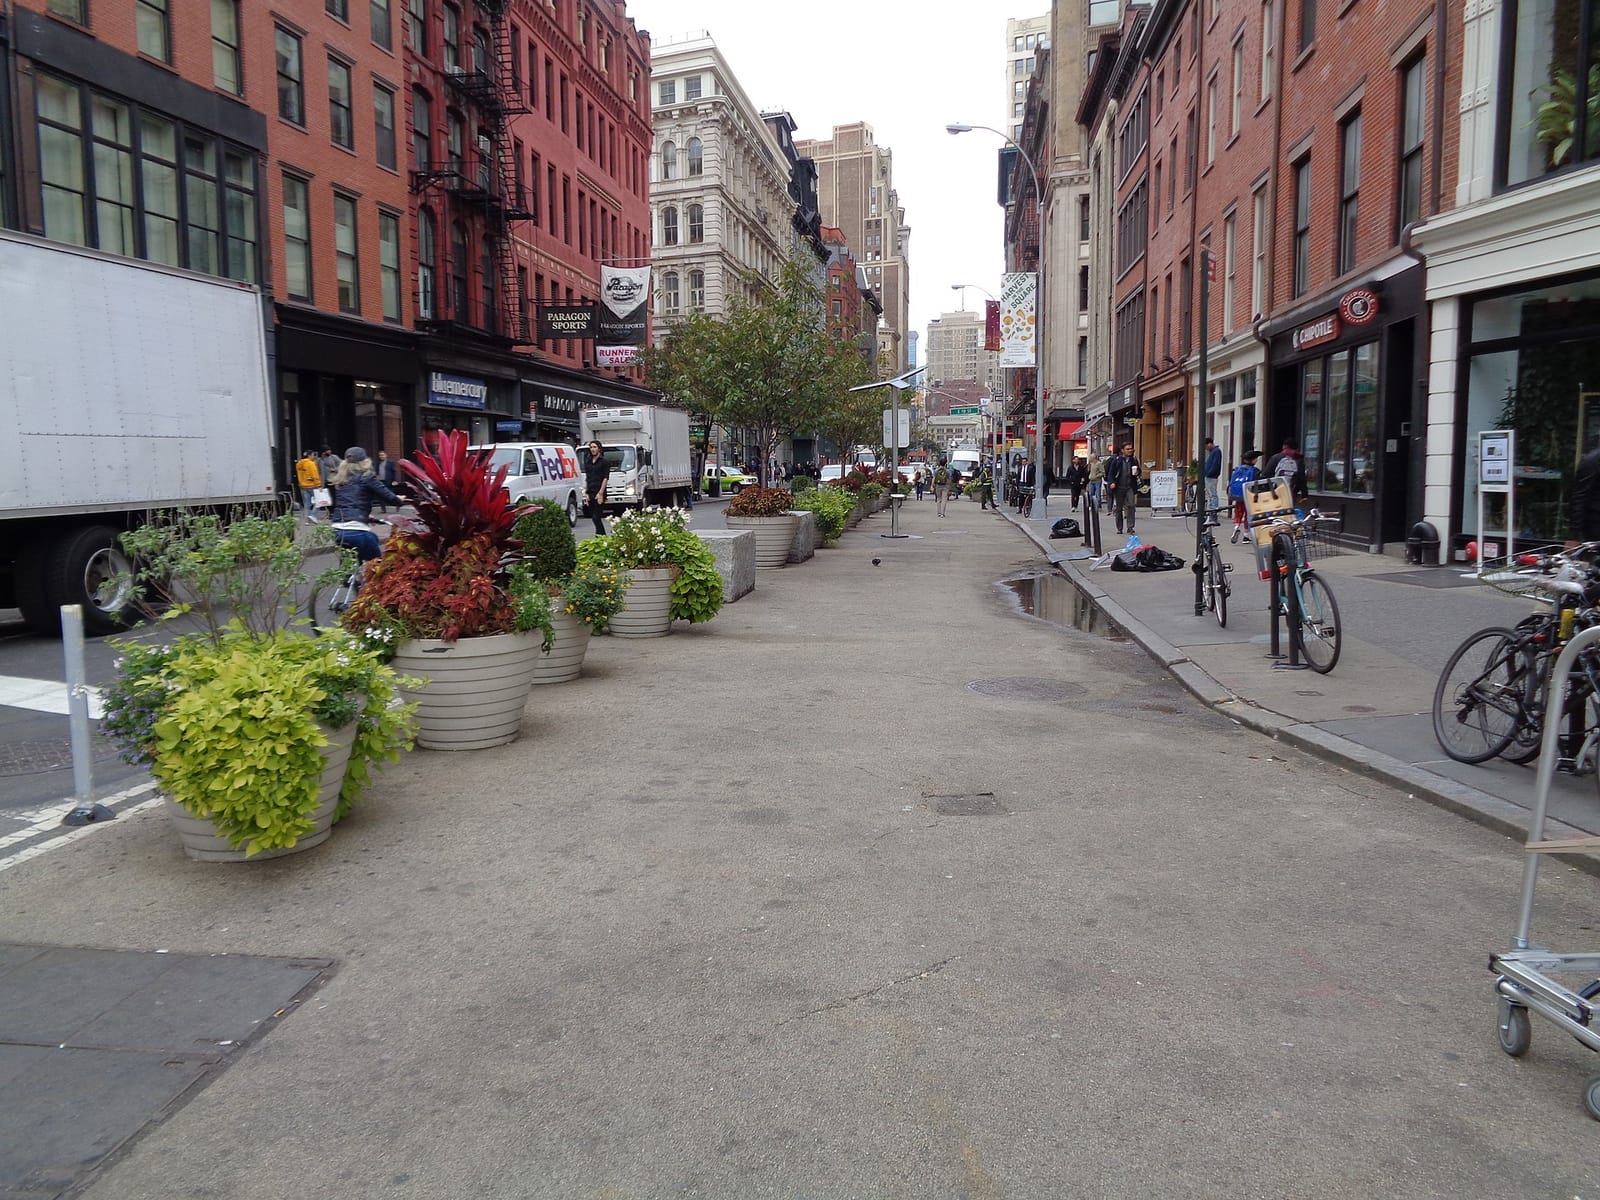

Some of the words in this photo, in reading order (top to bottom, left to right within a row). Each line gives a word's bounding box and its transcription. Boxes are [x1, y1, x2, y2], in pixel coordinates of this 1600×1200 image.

[606, 277, 644, 292] Paragon
[1000, 272, 1030, 303] HARVEST
[1010, 282, 1036, 309] SQUARE
[1342, 290, 1376, 306] CHIPOTLE
[547, 312, 591, 321] PARAGON
[551, 321, 587, 330] SPORTS
[1299, 318, 1333, 343] CHIPOTLE
[599, 349, 638, 357] RUNNER
[431, 371, 488, 403] bluemercury
[543, 394, 576, 412] PARAGON
[535, 447, 579, 481] FedEx
[1154, 475, 1174, 483] iStore
